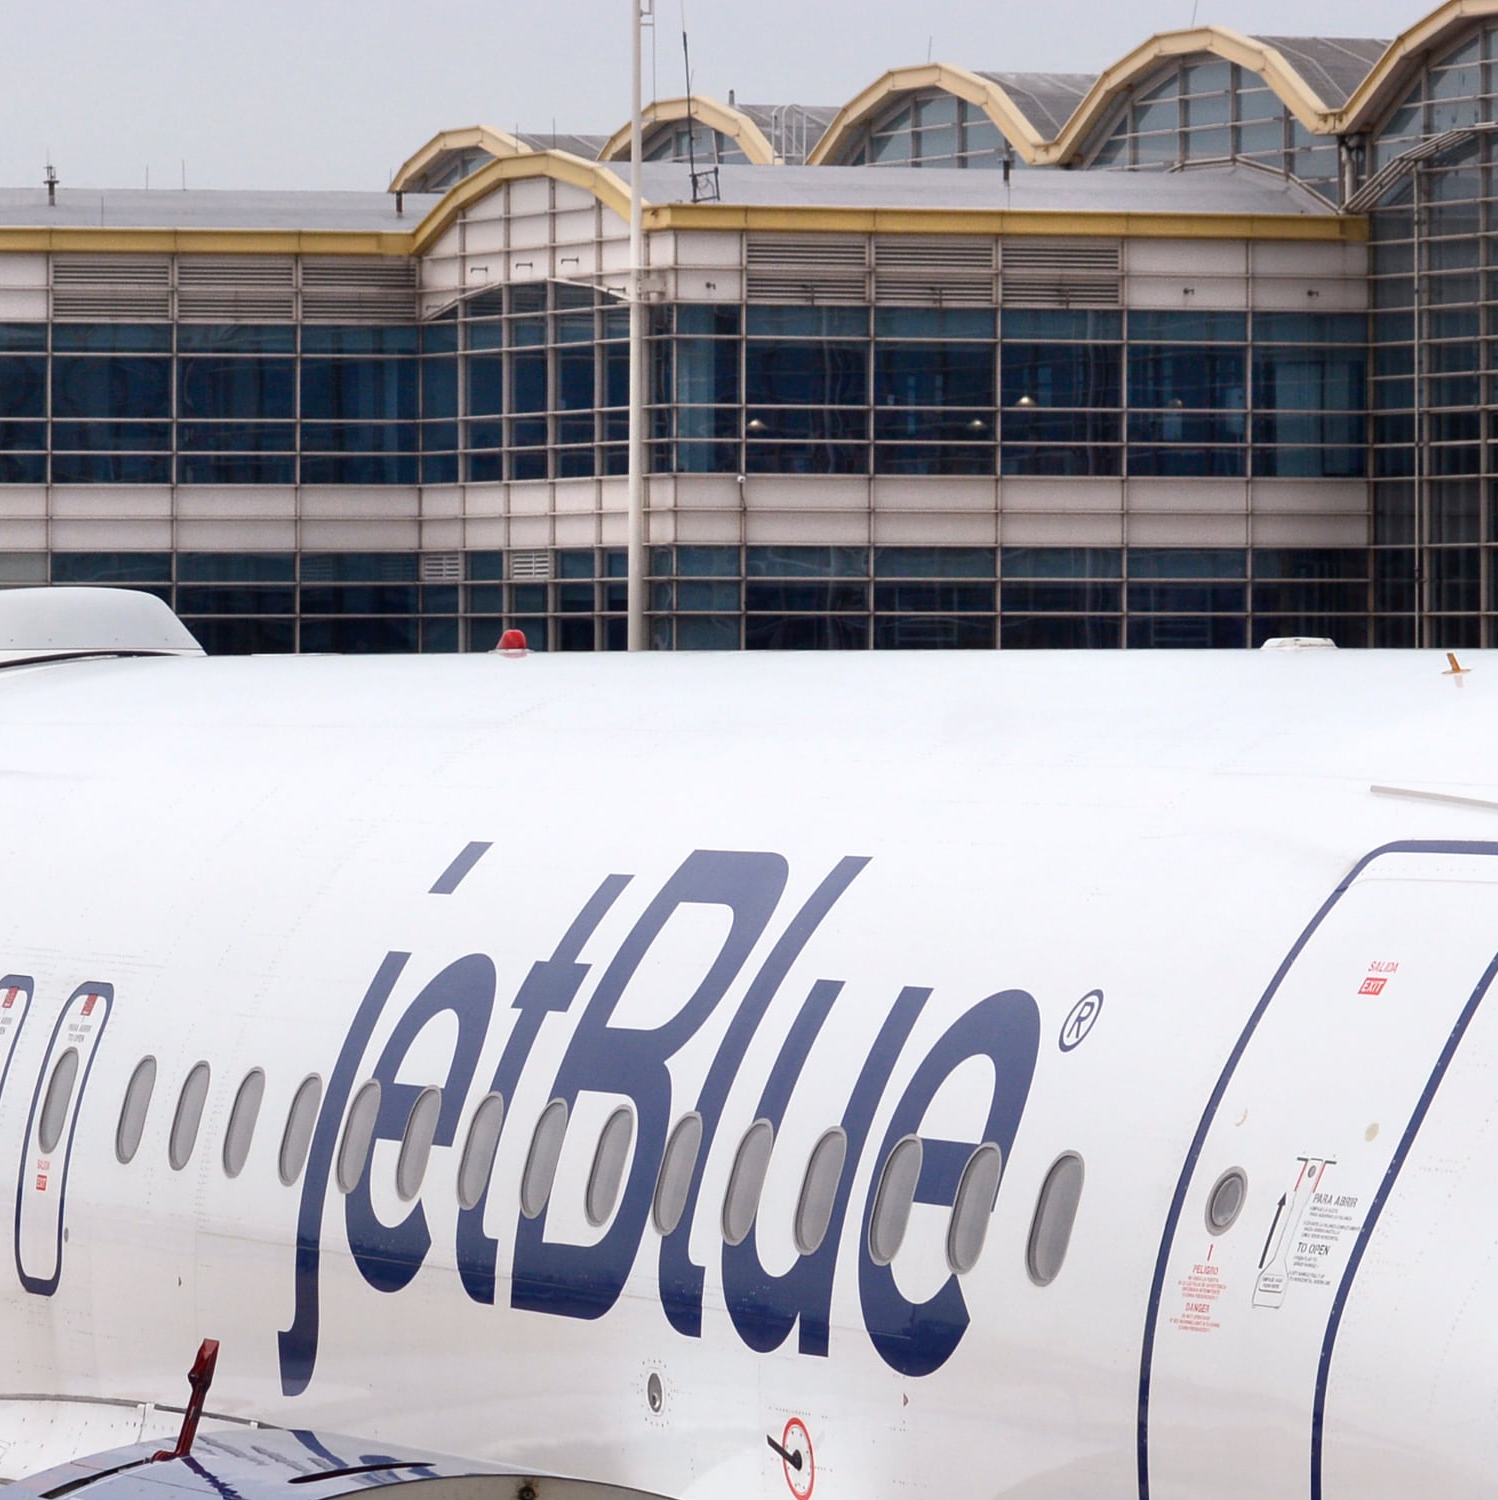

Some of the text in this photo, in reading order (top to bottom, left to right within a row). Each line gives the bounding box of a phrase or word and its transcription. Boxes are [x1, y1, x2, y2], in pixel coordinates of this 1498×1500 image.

[1360, 979, 1385, 993] EXIT
[277, 841, 1041, 1397] jetBlue
[1296, 1242, 1330, 1256] TO OPEN
